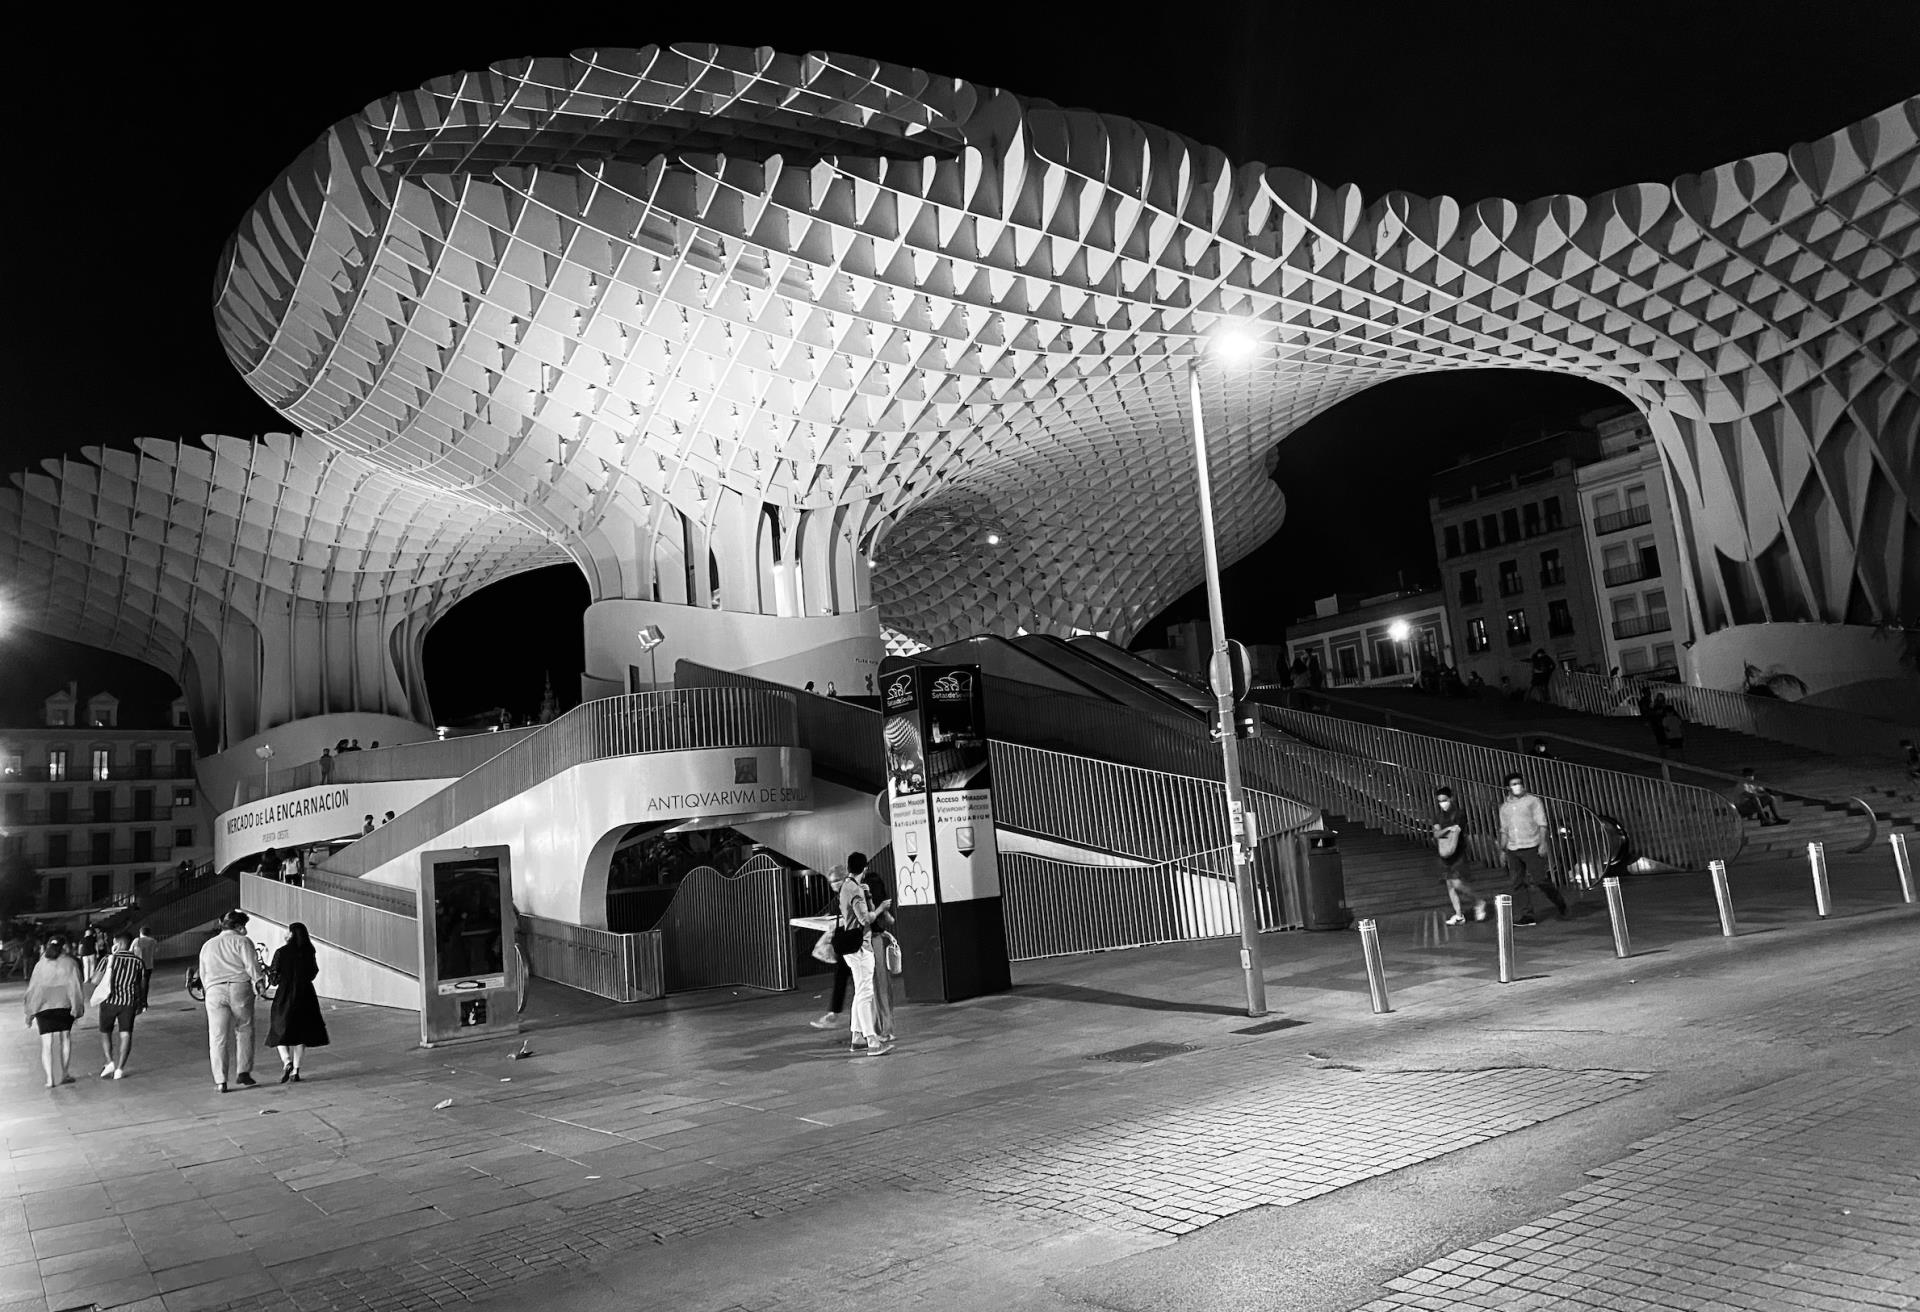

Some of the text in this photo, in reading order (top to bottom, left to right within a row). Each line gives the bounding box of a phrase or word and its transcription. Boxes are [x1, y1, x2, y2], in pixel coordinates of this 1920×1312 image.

[227, 788, 349, 835] MERCADO DE LA ENCARNACION
[647, 787, 808, 812] ANTIQVARIVM DE SEVILLA
[937, 814, 990, 823] ANTIQUARIUM
